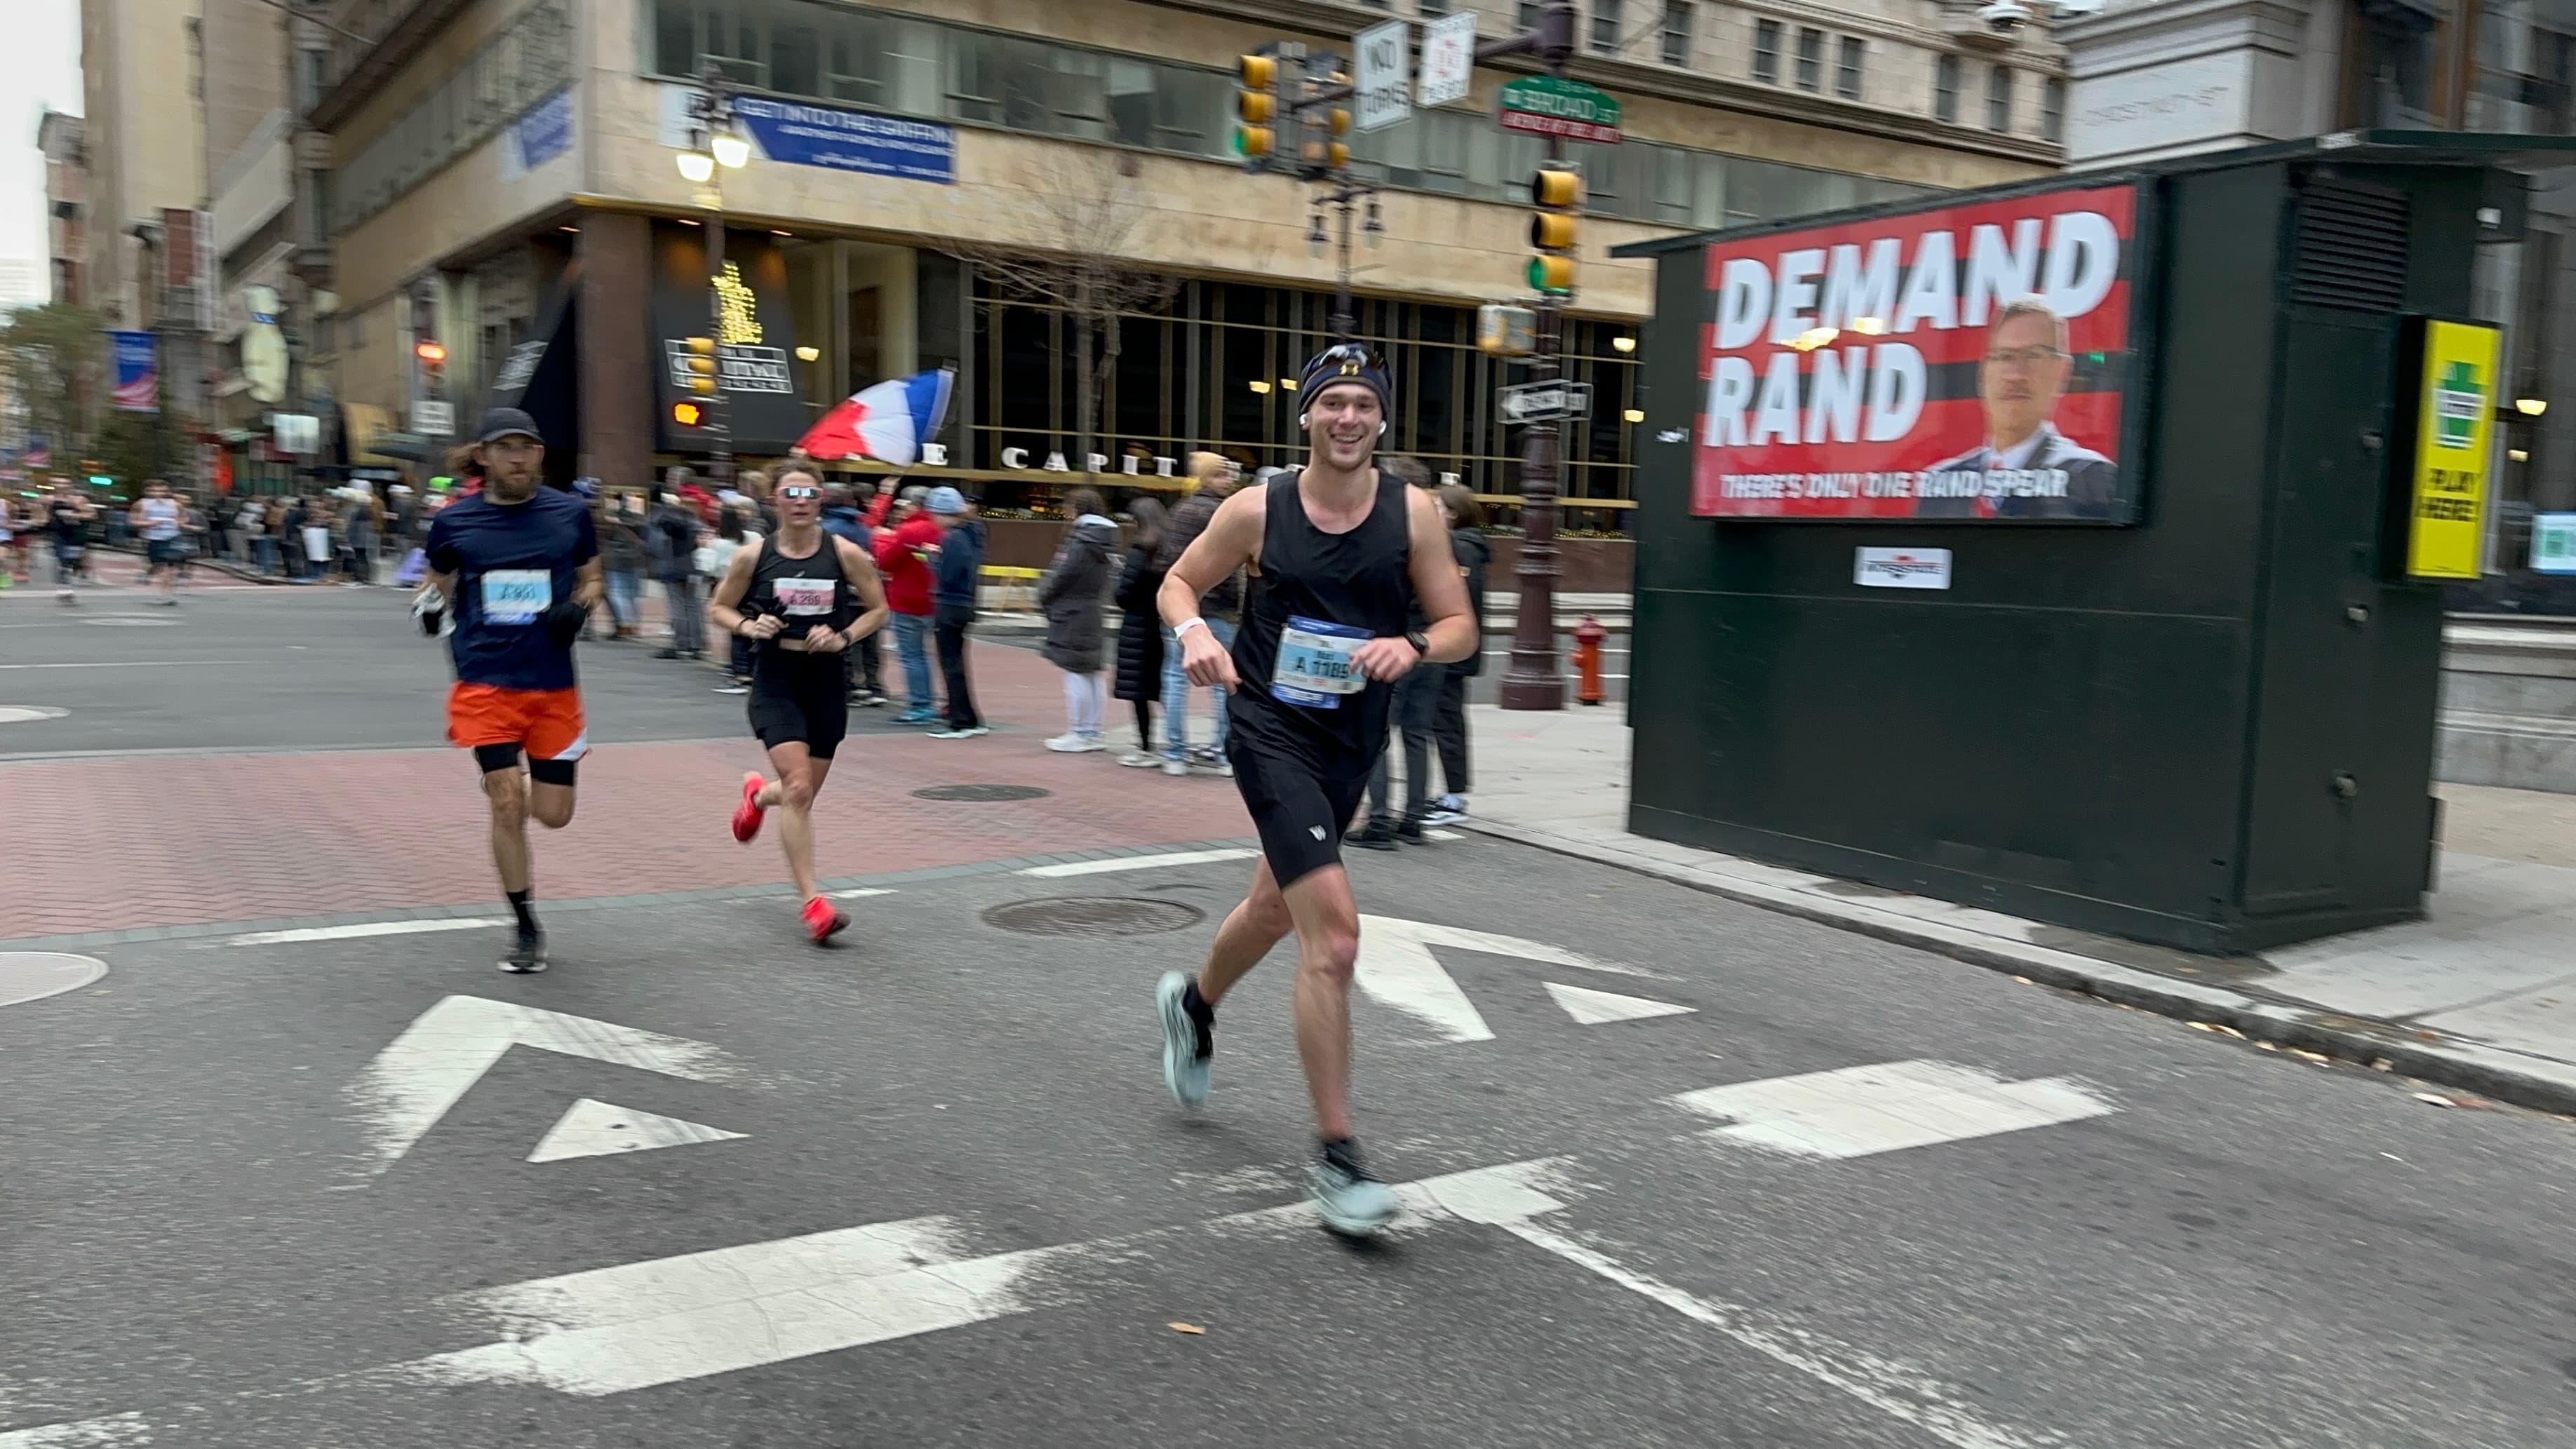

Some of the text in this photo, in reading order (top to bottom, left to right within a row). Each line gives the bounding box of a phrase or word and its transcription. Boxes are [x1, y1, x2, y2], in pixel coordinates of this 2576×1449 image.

[1521, 88, 1599, 121] BROAD
[1712, 211, 2120, 350] DEMAND
[1703, 342, 1928, 447] RAND
[1001, 447, 1179, 478] CAPIT
[1720, 473, 1804, 499] THERE'S
[1804, 473, 1862, 499] ONLY
[1914, 470, 1983, 499] RAND
[1982, 469, 2069, 499] SPEAR
[1294, 656, 1306, 673] A
